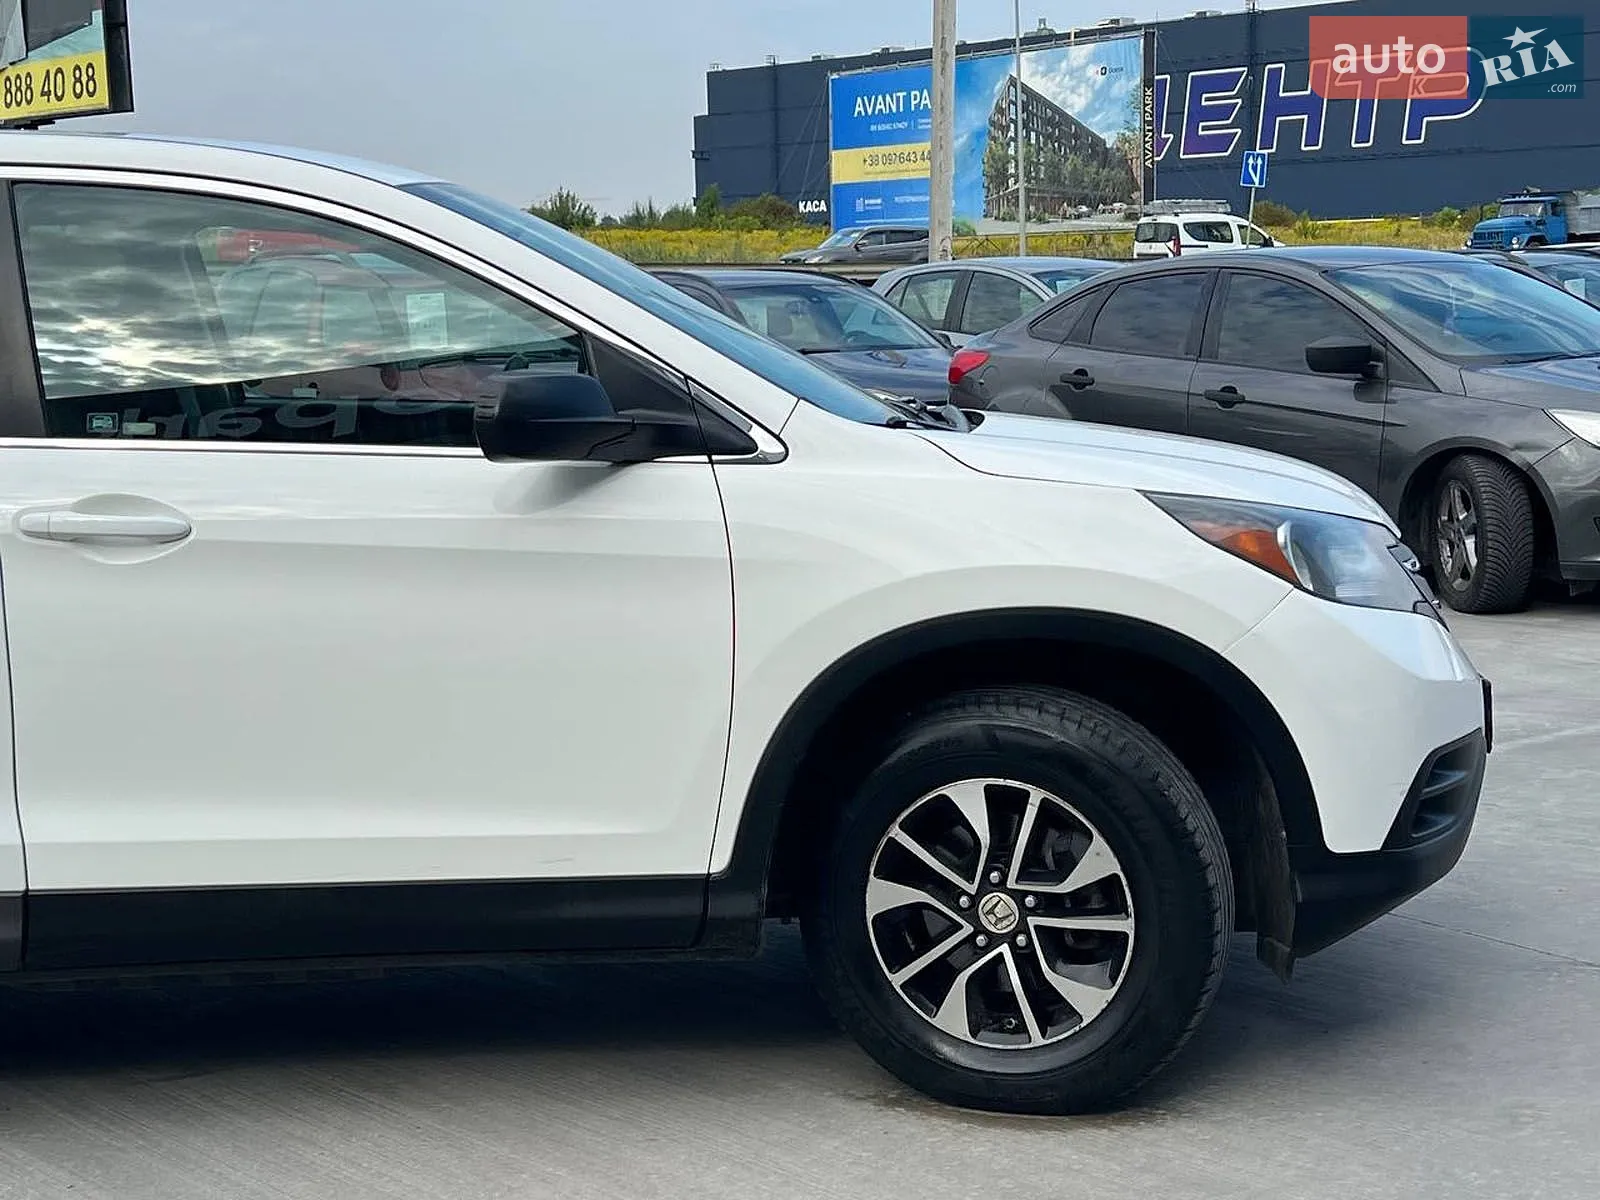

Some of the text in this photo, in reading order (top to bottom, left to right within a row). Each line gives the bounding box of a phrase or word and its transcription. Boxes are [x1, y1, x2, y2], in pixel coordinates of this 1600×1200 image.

[4, 62, 98, 109] 888 40 88
[853, 91, 907, 118] AVANT
[1144, 87, 1153, 169] AVANT PARK
[798, 199, 827, 214] КАСА
